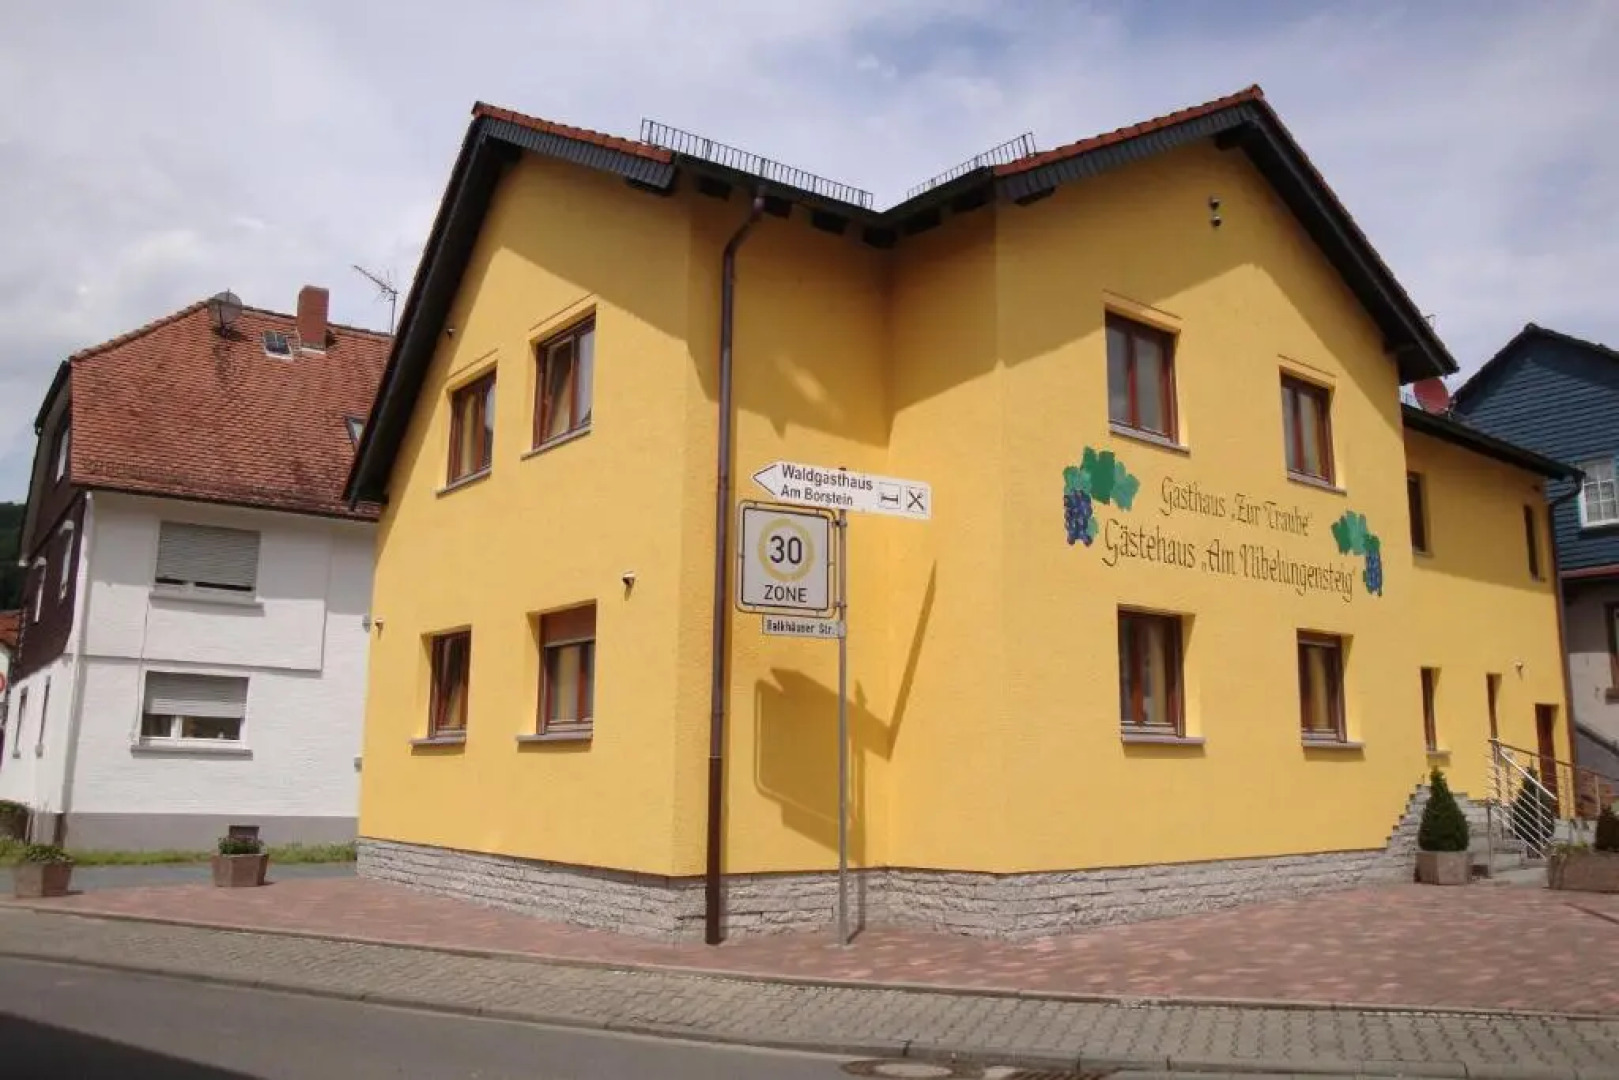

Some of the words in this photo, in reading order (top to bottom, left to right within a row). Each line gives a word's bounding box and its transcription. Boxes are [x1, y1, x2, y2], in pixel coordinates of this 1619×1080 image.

[782, 464, 873, 491] Waldgasthaus
[780, 484, 801, 499] Am
[804, 486, 853, 507] Borstein
[1159, 476, 1226, 517] Gasthaus
[769, 535, 803, 564] 30
[1101, 518, 1196, 568] Gästehaus
[764, 584, 808, 603] ZONE
[818, 623, 836, 635] Str.
